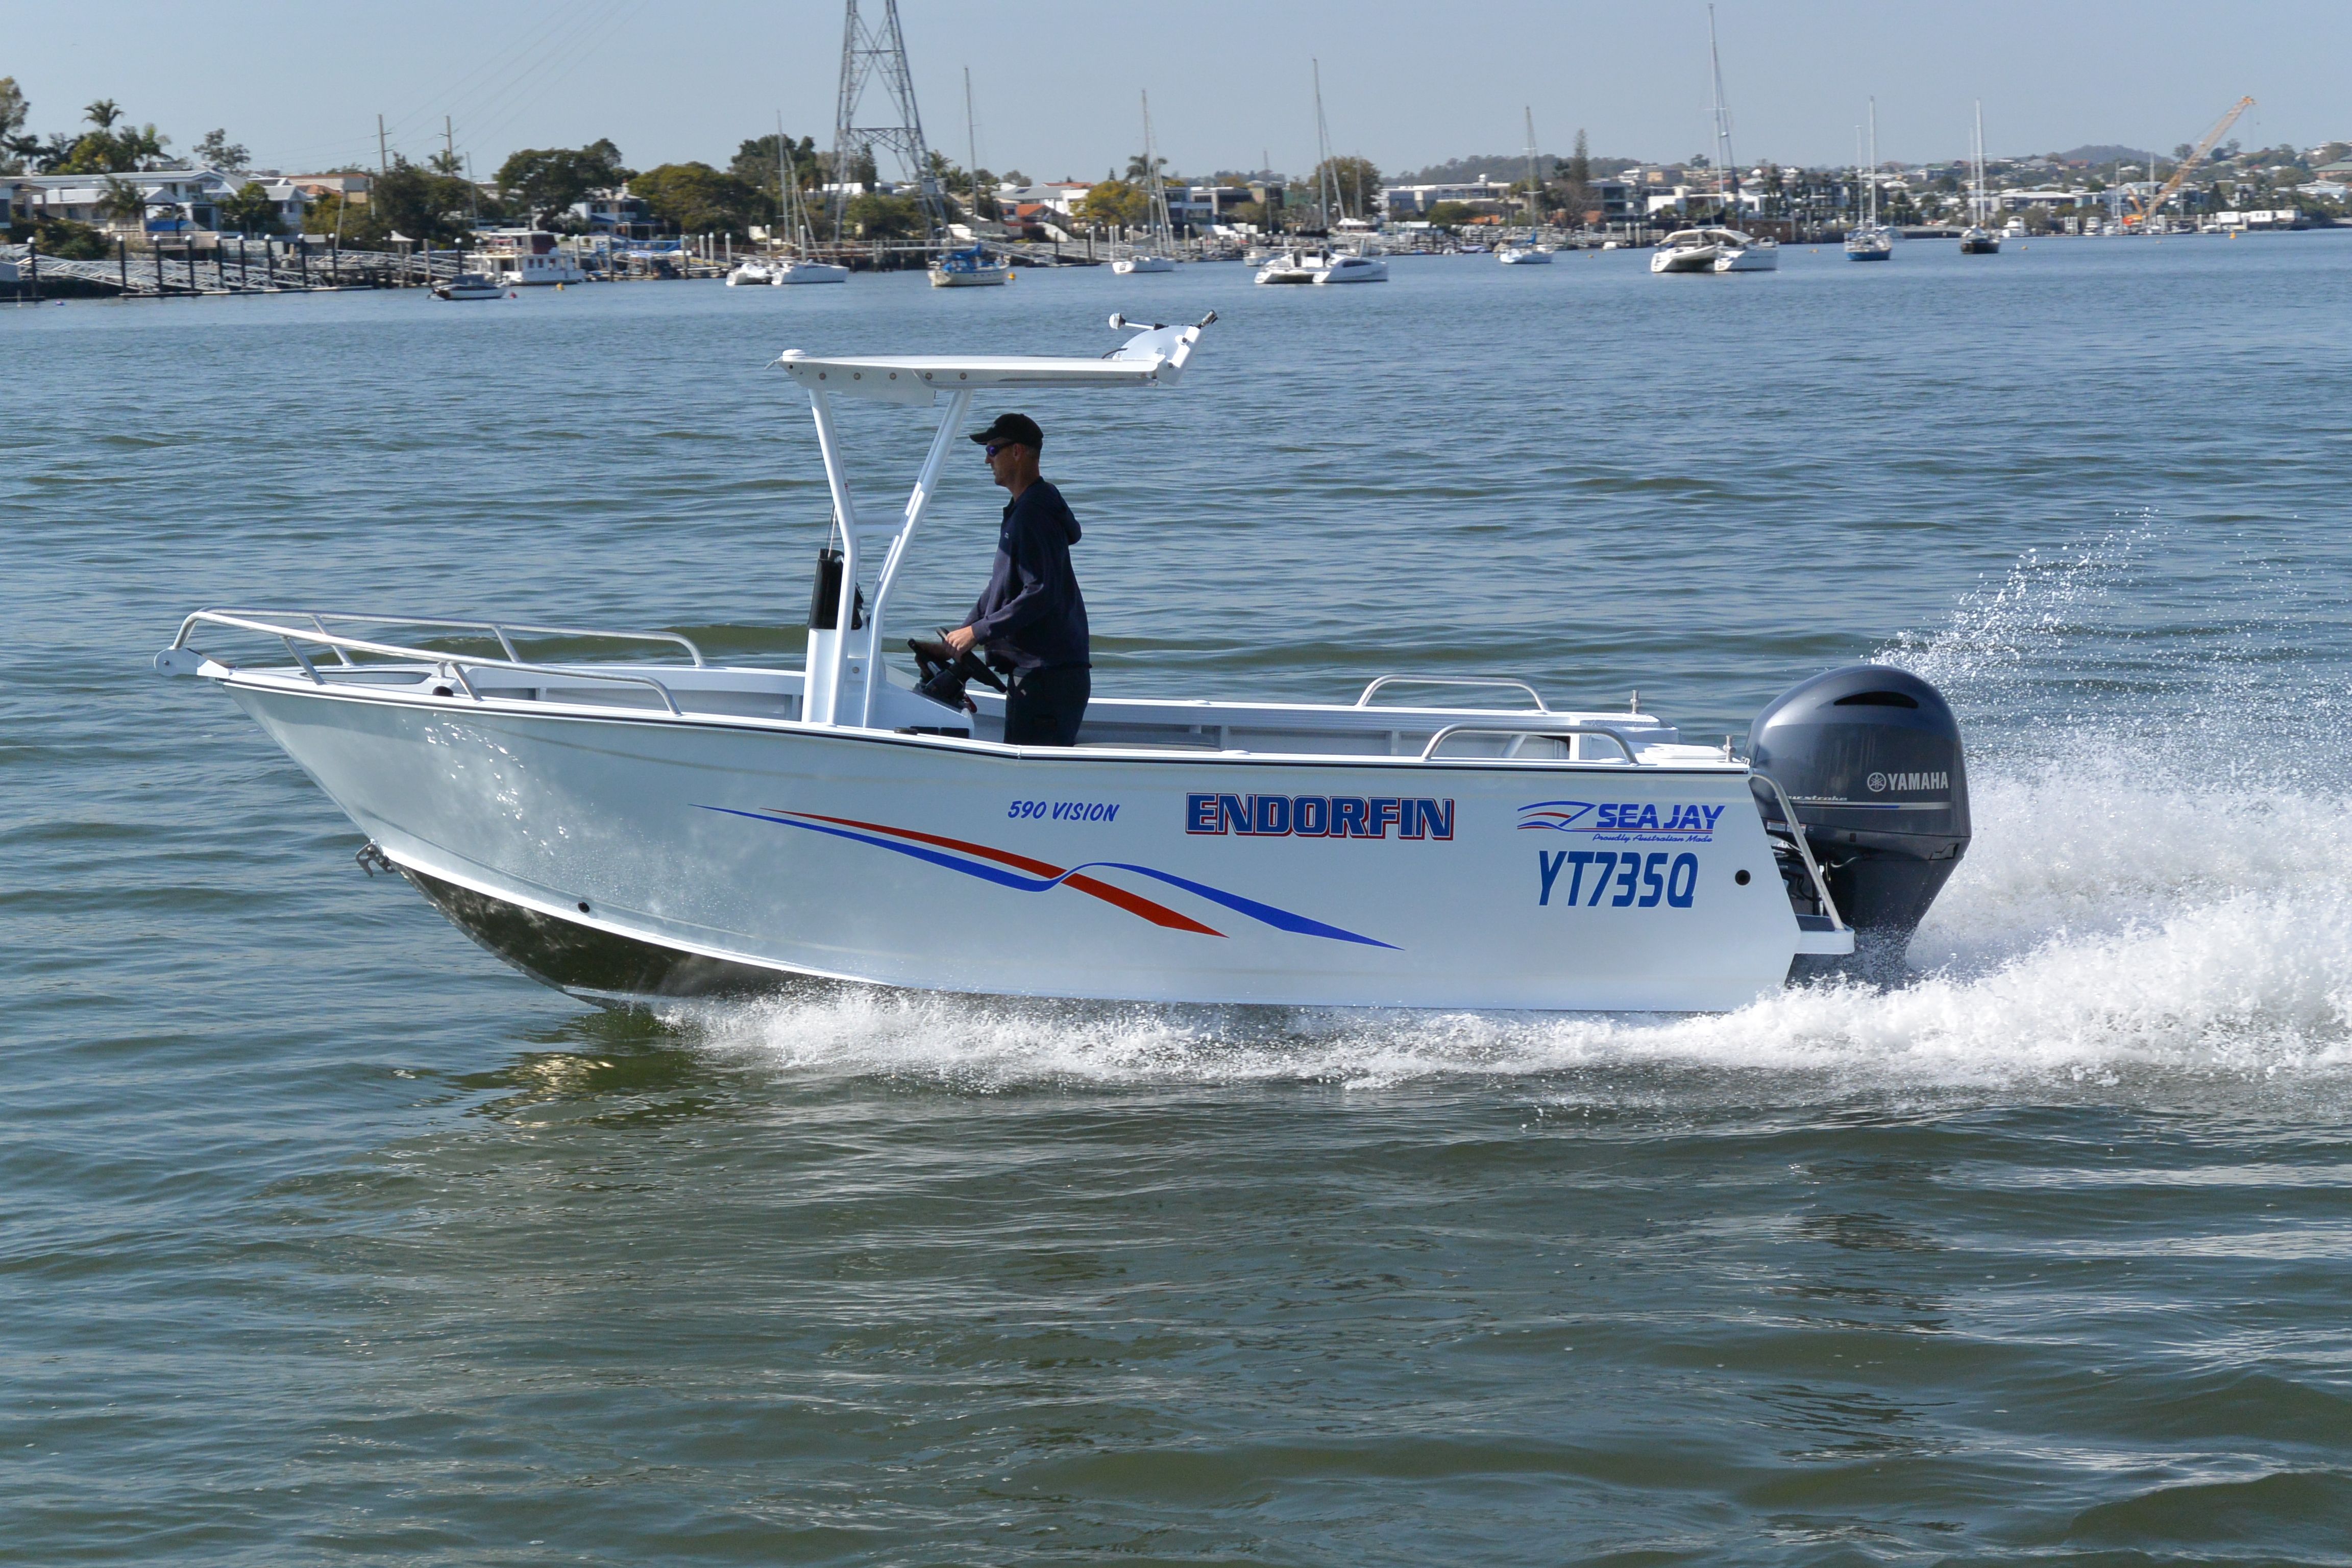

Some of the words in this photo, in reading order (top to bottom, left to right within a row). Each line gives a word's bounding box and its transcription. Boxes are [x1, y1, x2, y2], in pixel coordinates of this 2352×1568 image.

[1888, 772, 1949, 791] YAMAHA
[1008, 800, 1047, 819] 590
[1052, 802, 1120, 822] VISION
[1185, 792, 1455, 841] ENDORFIN
[1596, 803, 1659, 828] SEA
[1663, 804, 1726, 829] JAY
[1592, 833, 1631, 843] Proudly
[1633, 834, 1684, 842] Australian
